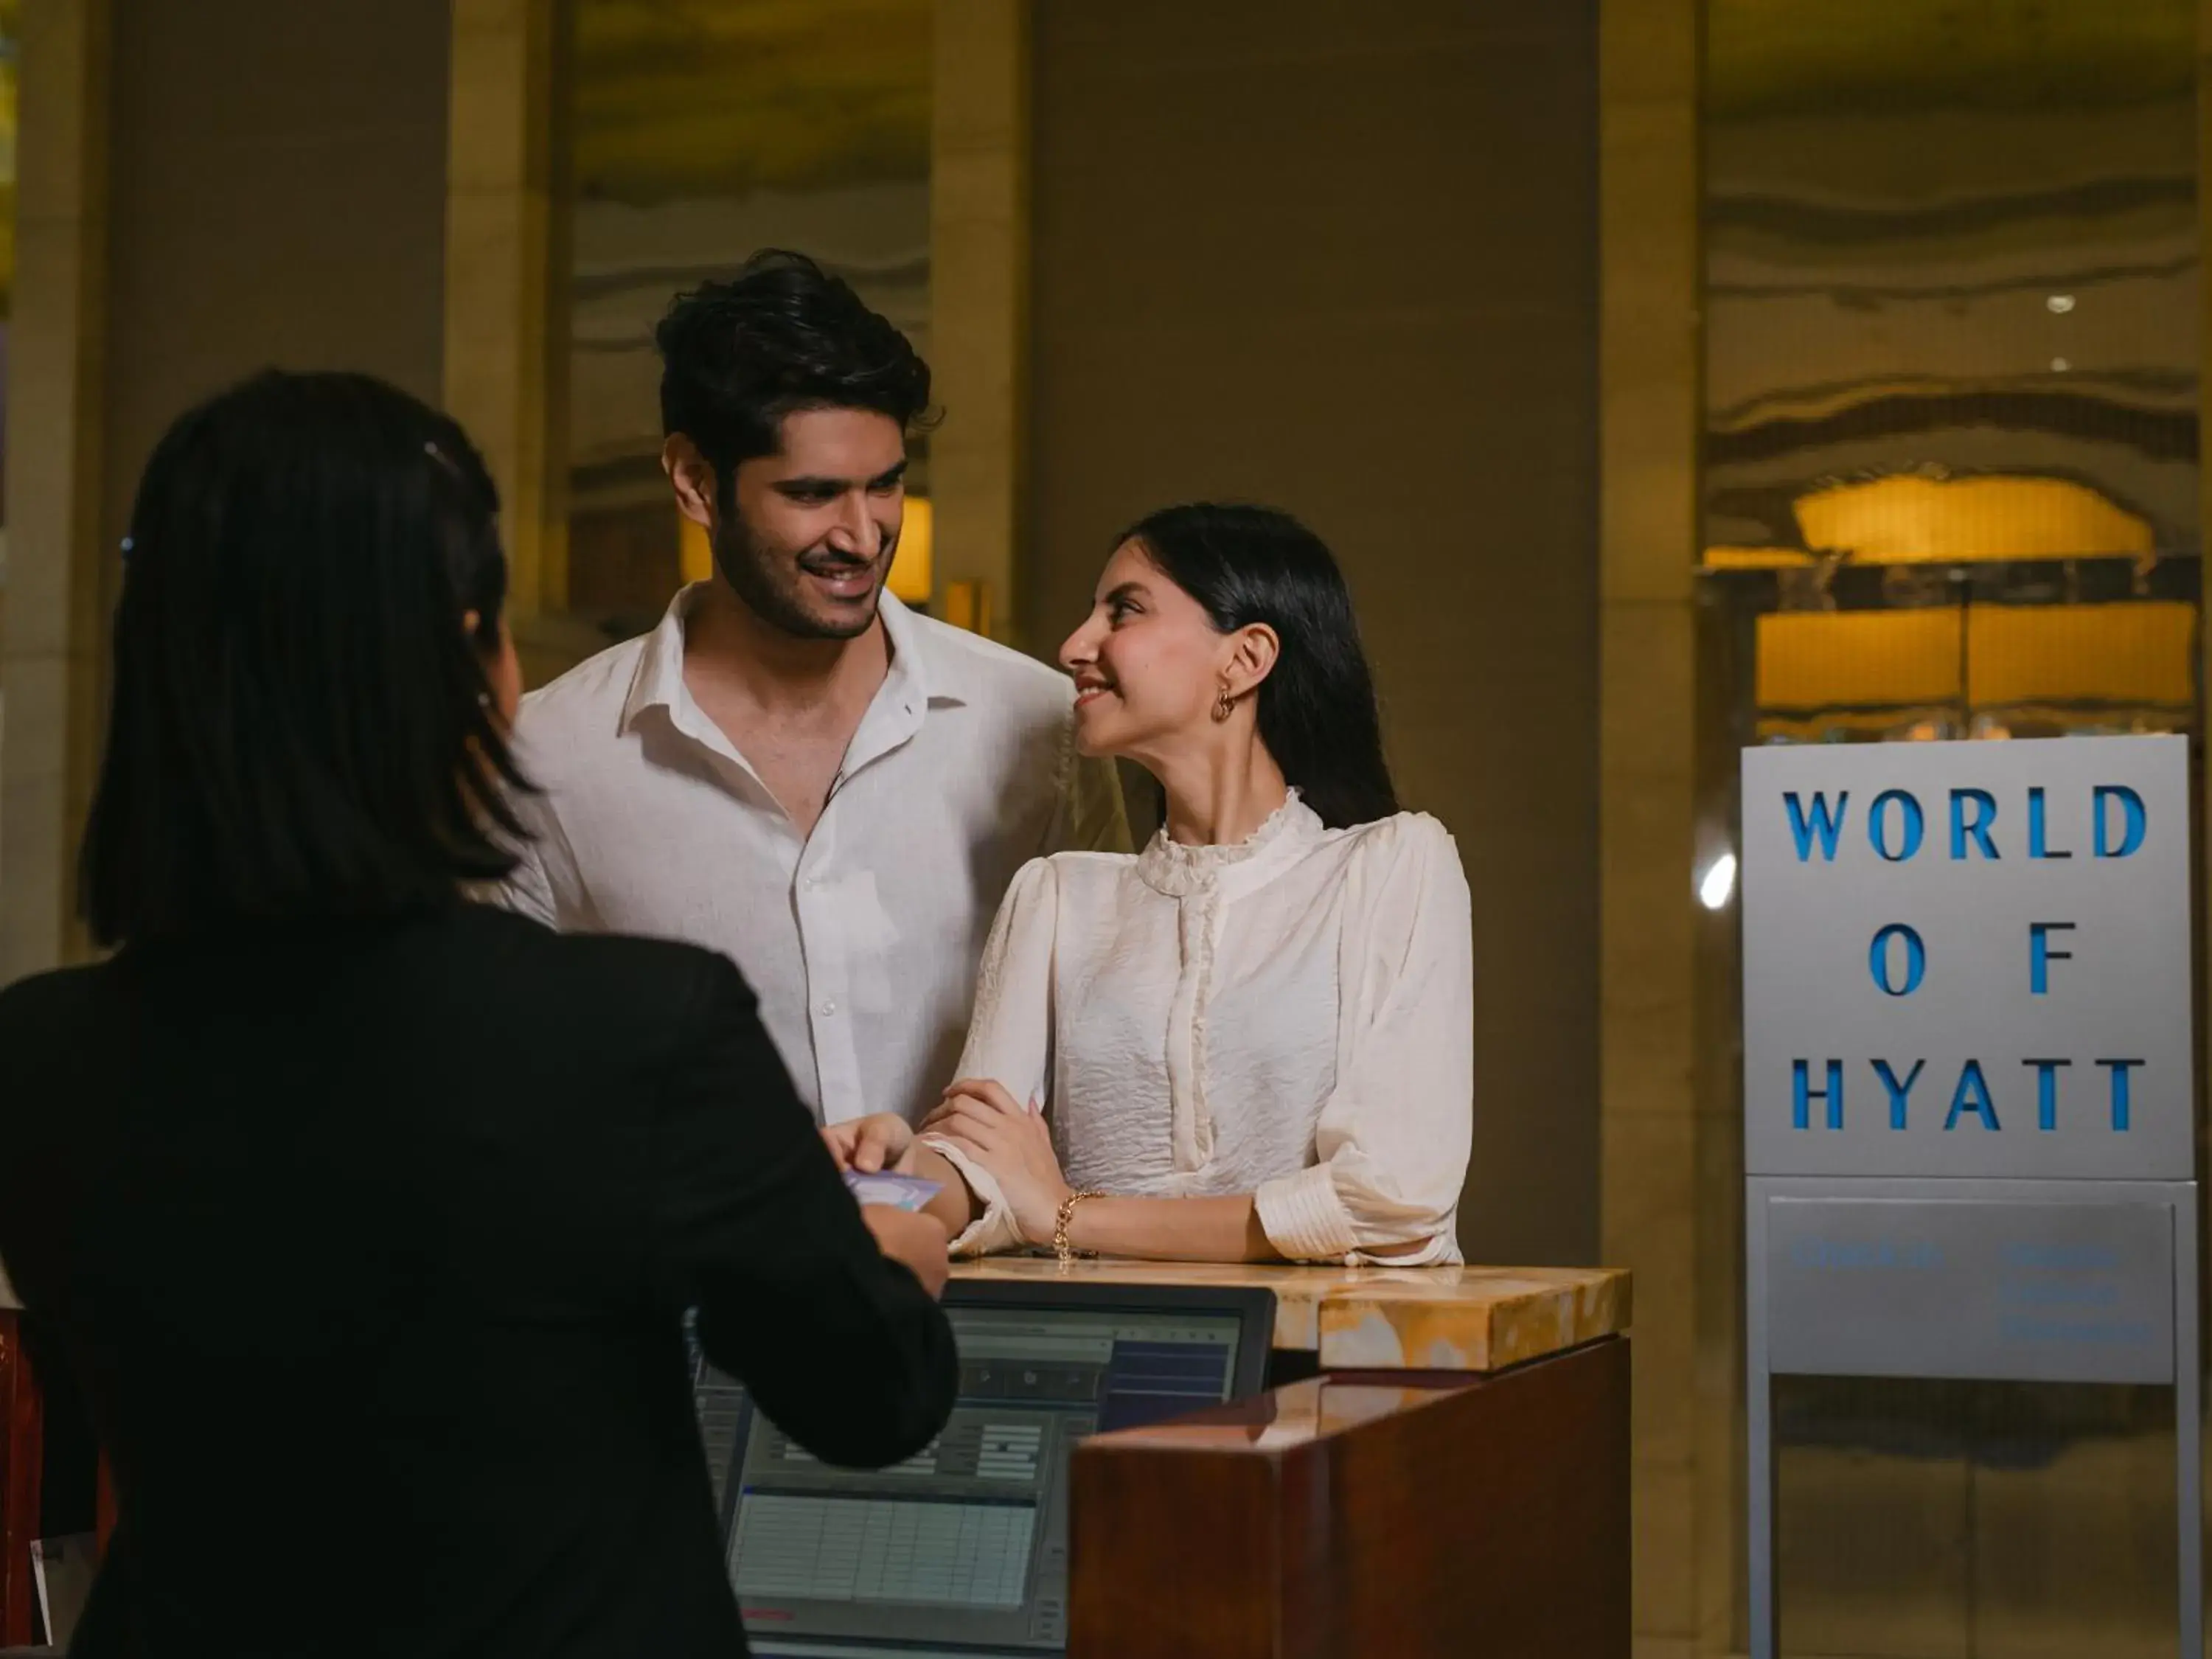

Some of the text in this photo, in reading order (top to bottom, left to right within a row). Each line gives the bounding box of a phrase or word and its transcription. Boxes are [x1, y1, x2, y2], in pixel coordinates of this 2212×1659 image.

[1783, 785, 2147, 862] WORLD
[1868, 922, 2076, 997] OF
[1792, 1058, 2146, 1132] HYATT
